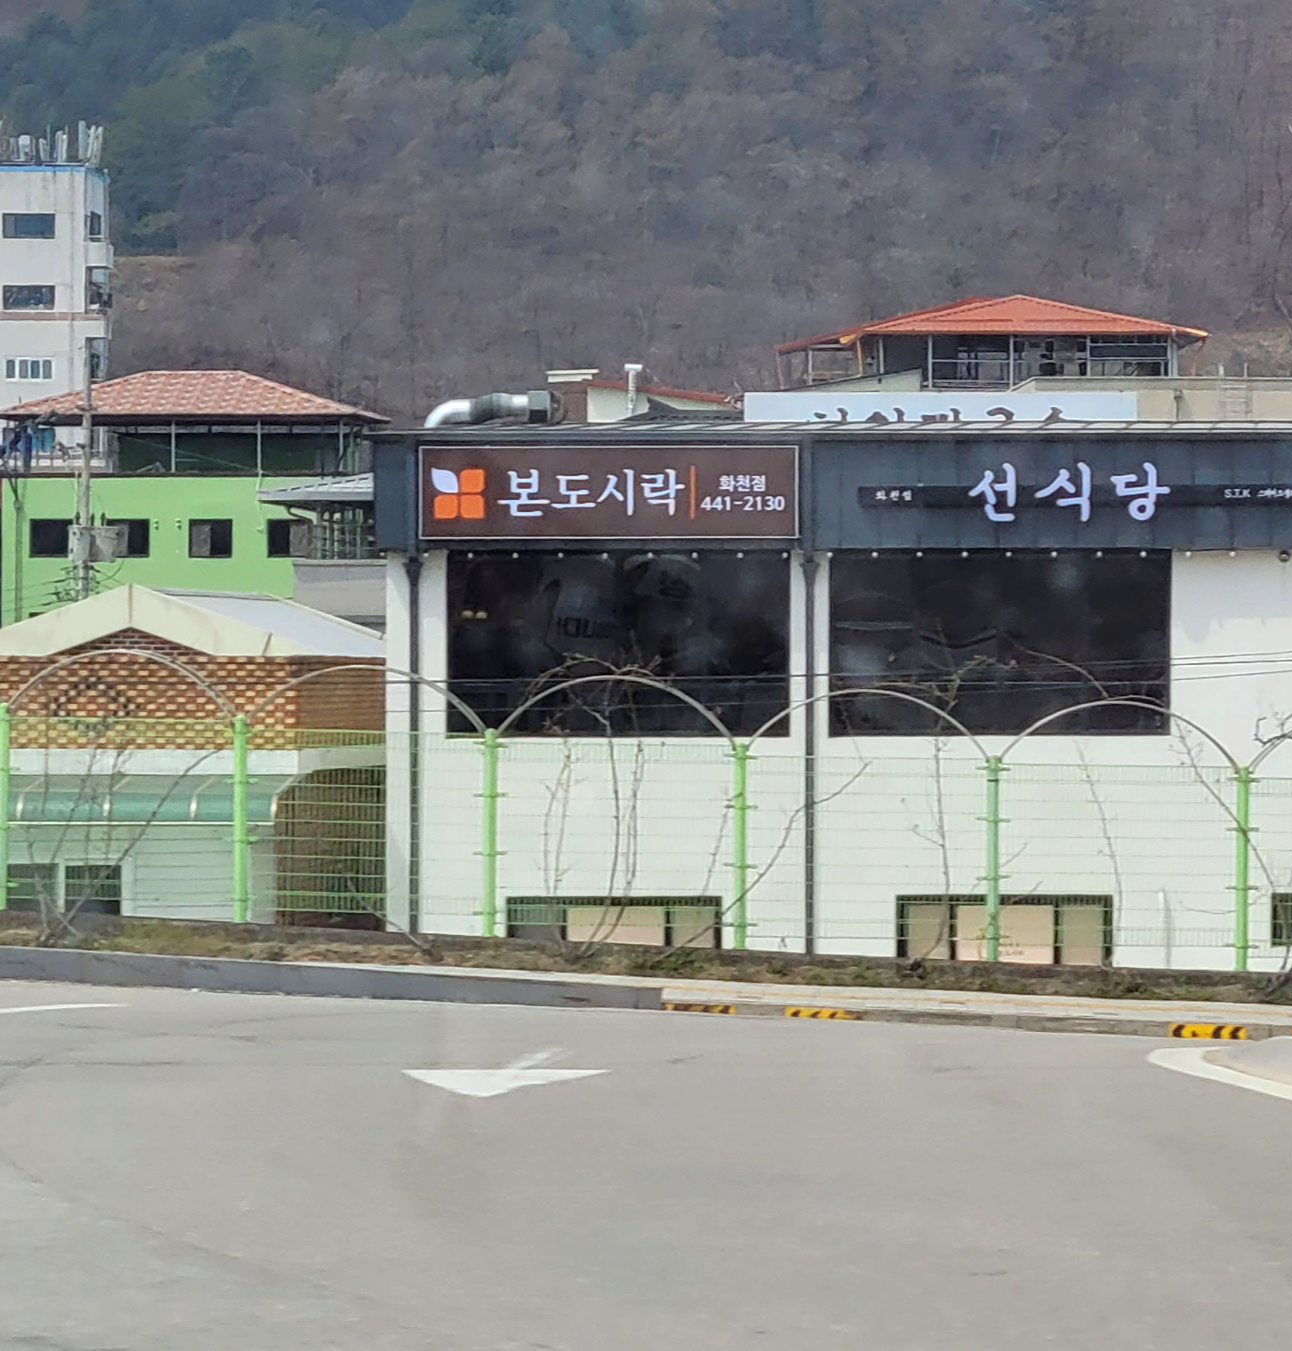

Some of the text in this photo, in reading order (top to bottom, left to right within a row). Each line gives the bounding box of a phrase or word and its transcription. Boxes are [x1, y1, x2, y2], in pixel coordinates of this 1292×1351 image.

[497, 468, 686, 517] 본도시락
[718, 474, 767, 492] 화천점
[968, 461, 1171, 523] 선식당
[700, 496, 786, 512] 441-2130
